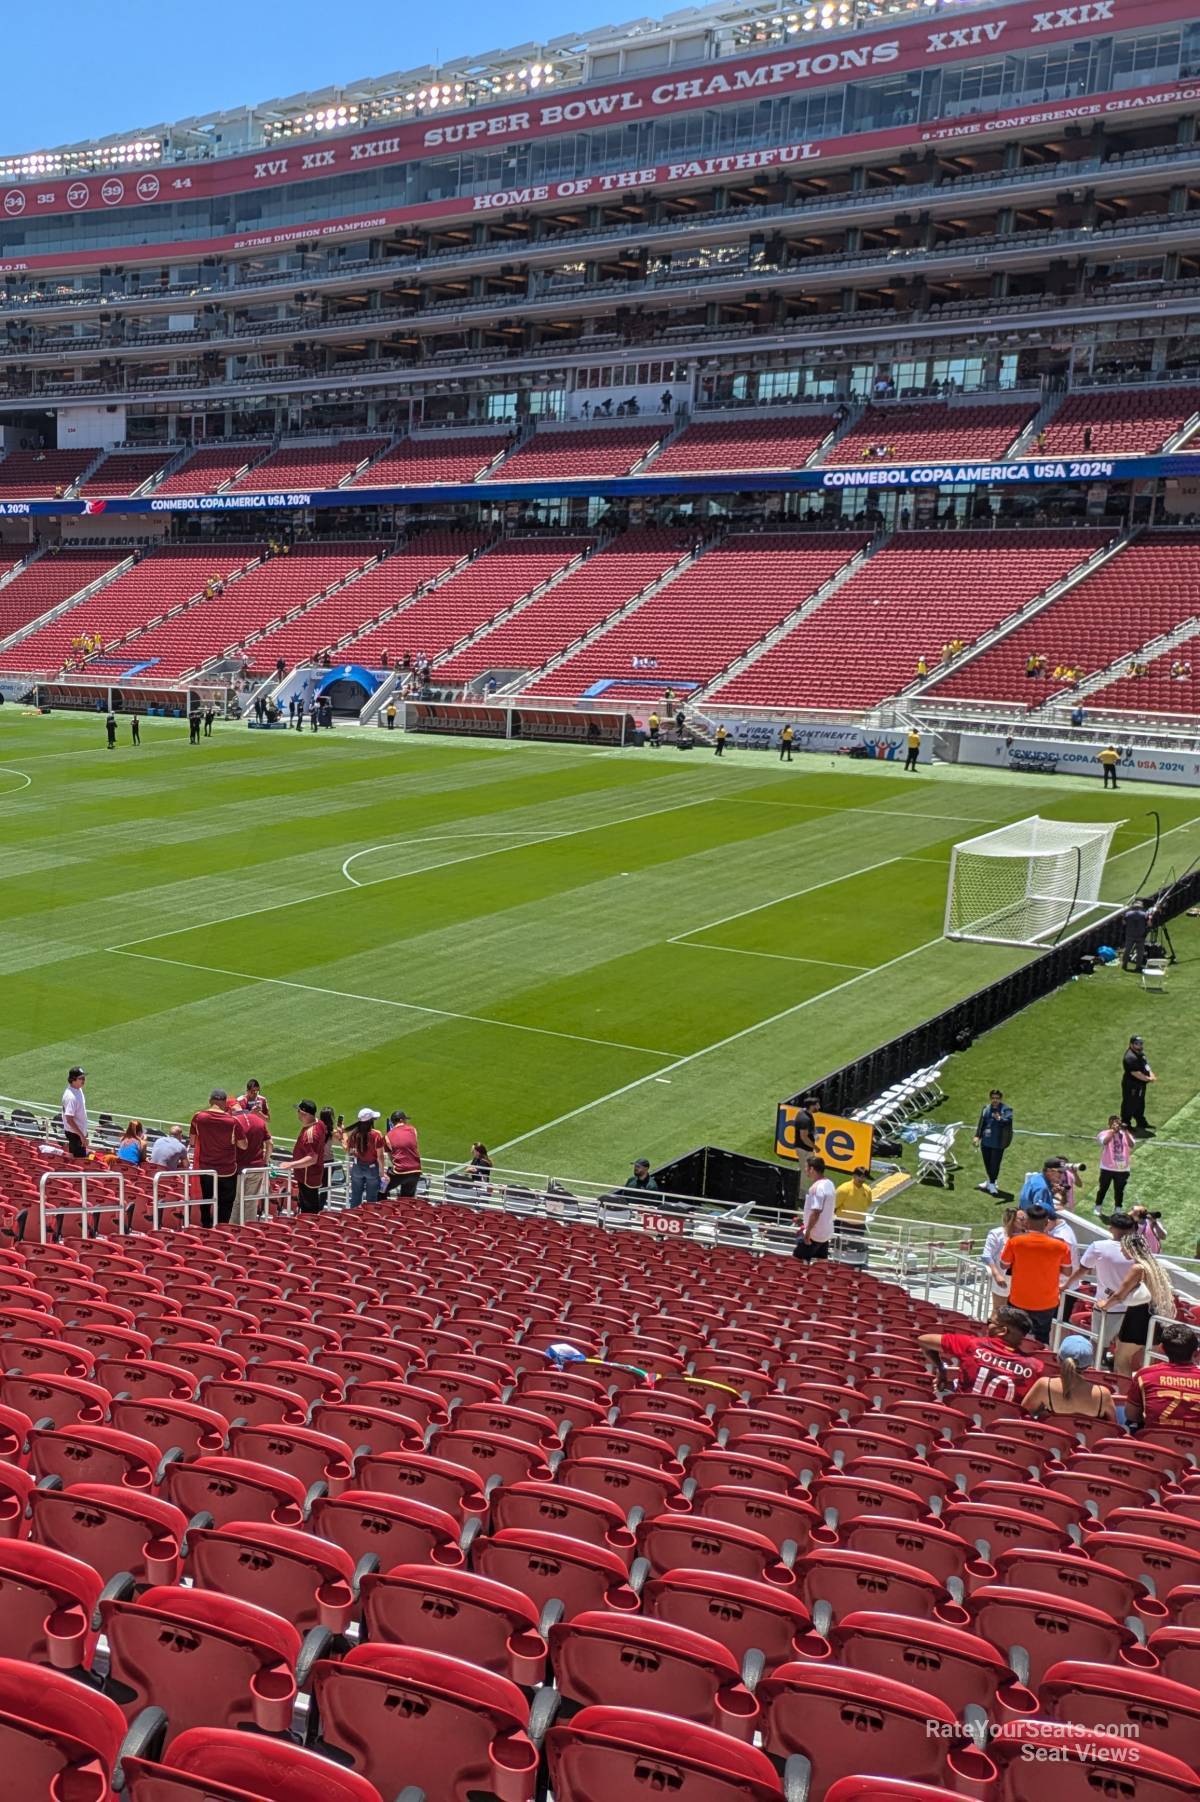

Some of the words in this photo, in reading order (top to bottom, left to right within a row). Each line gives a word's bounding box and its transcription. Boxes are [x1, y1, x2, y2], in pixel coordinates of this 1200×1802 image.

[925, 20, 1008, 53] XXIV
[1030, 0, 1115, 33] XXIX
[423, 112, 530, 147] SUPER
[539, 92, 643, 126] BOWL
[650, 40, 900, 103] CHAMPIONS
[921, 123, 981, 141] 8-TIME
[984, 103, 1101, 132] CONFERENCE
[253, 158, 288, 179] XVI
[301, 149, 336, 171] XIX
[349, 137, 401, 160] XXIII
[171, 177, 192, 189] 44
[472, 184, 548, 211] HOME
[556, 178, 592, 198] OF
[599, 169, 657, 191] THE
[666, 143, 821, 182] FAITHFUL
[69, 189, 87, 201] 37
[103, 186, 122, 197] 39
[138, 182, 158, 193] 42
[6, 196, 24, 207] 34
[37, 193, 55, 205] 35
[274, 229, 320, 244] DIVISION
[321, 218, 386, 235] CHAMPIONS
[823, 471, 909, 487] CONMEBOL
[910, 469, 954, 483] COPA
[954, 466, 1030, 482] AMERICA
[1033, 464, 1066, 479] USA
[1069, 462, 1113, 477] 2024
[7, 503, 30, 514] 2024
[151, 499, 200, 510] CONMEBOL
[200, 498, 224, 508] COPA
[224, 496, 266, 507] AMERICA
[267, 495, 286, 506] USA
[287, 494, 310, 505] 2024
[1063, 753, 1090, 764] COPA
[1137, 760, 1157, 770] USA
[1158, 762, 1185, 773] 2024
[646, 1216, 681, 1234] 108
[974, 1348, 1033, 1379] SOTELDO
[972, 1366, 1015, 1402] 10
